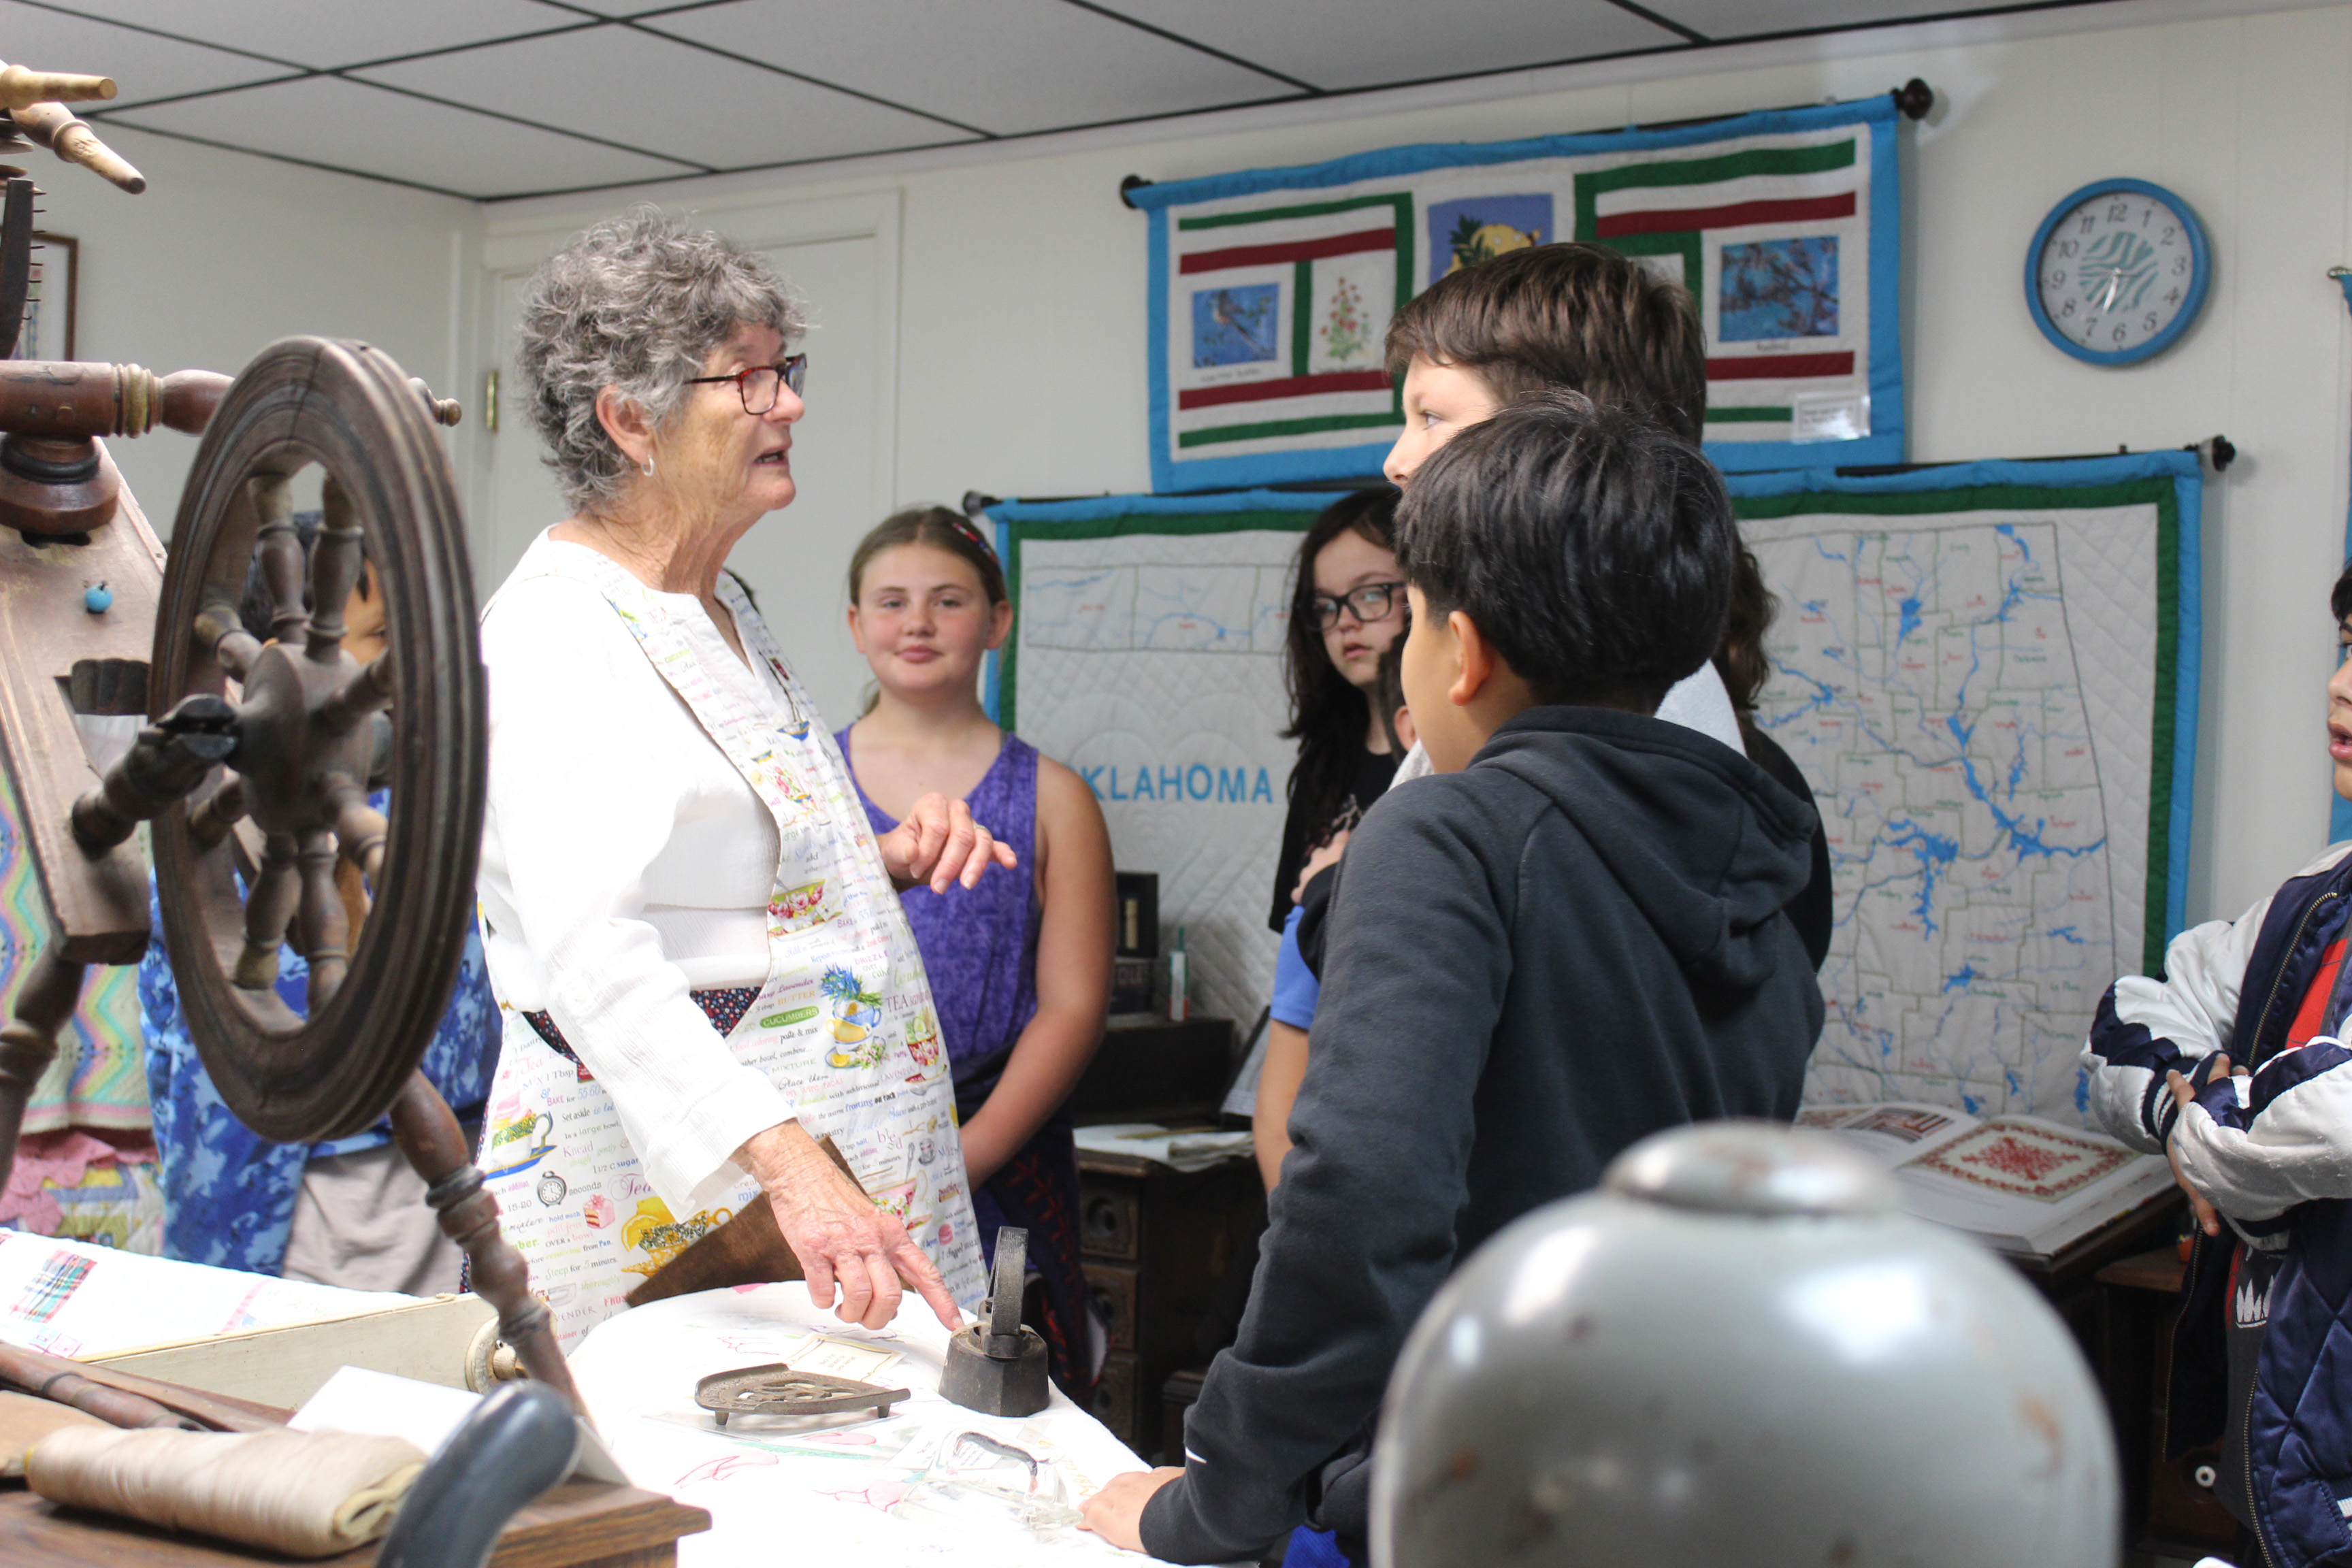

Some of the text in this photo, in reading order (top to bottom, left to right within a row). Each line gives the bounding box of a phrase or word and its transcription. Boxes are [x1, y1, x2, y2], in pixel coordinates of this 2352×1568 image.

[2107, 203, 2127, 223] 12
[2142, 209, 2151, 227] 1
[2080, 216, 2095, 234] 11
[2161, 225, 2175, 246] 2
[2058, 240, 2080, 259] 10
[2172, 257, 2187, 276] 3
[2051, 270, 2066, 289] 9
[2163, 287, 2178, 306] 4
[2061, 298, 2076, 317] 8
[2086, 317, 2097, 337] 7
[2143, 311, 2157, 332] 5
[2112, 323, 2125, 342] 6
[1066, 762, 1273, 803] KLAHOMA
[855, 950, 889, 965] DRIZZLE
[886, 994, 909, 1013] TEA
[762, 1007, 817, 1027] CUCUMBERS
[805, 1027, 818, 1035] mix
[552, 1068, 574, 1080] Tbsp
[772, 1059, 817, 1073] MIXTURE
[881, 1065, 915, 1082] LAVENDER
[823, 1076, 843, 1088] racks
[829, 1090, 845, 1100] with
[846, 1080, 880, 1094] additional
[546, 1094, 565, 1107] BAKE
[845, 1098, 873, 1112] frosting
[573, 1107, 591, 1120] aside
[579, 1125, 602, 1136] large
[564, 1141, 593, 1158] Knead
[616, 1158, 639, 1168] sugar
[549, 1215, 564, 1223] hold
[545, 1238, 566, 1247] OVER
[583, 1243, 598, 1252] from
[545, 1267, 569, 1281] Steep
[570, 1264, 581, 1273] for
[581, 1274, 621, 1291] thoroughly
